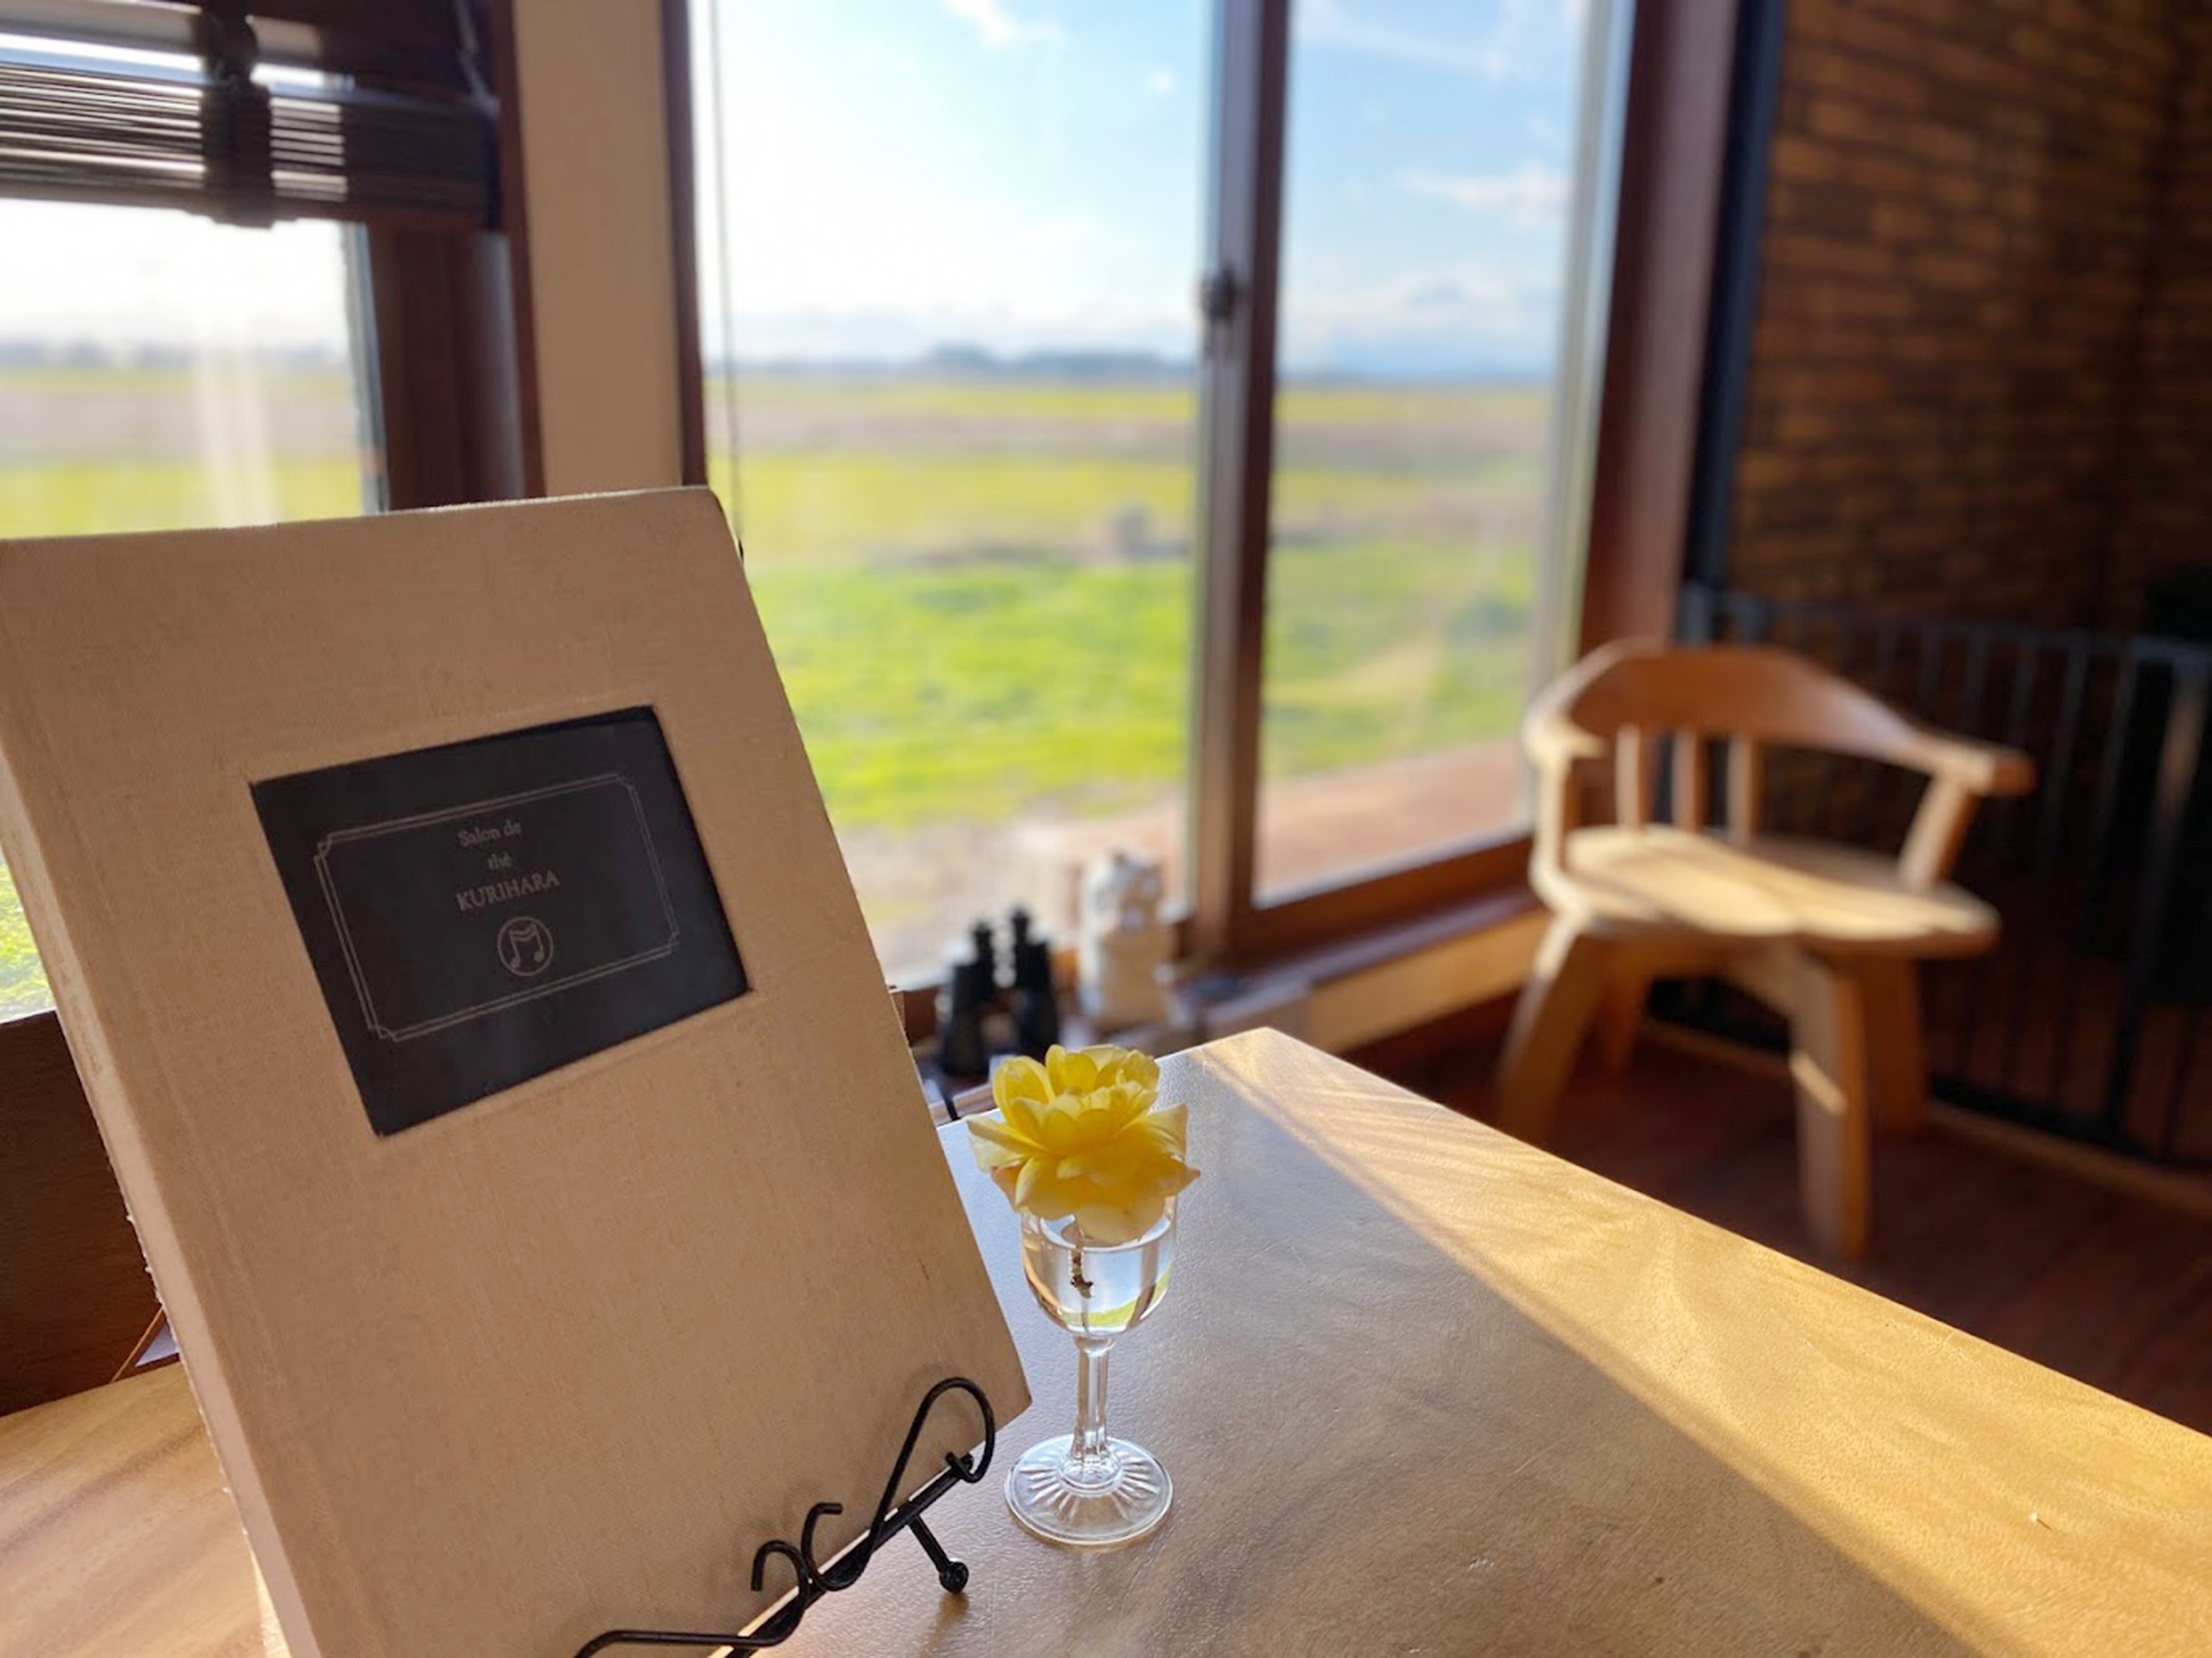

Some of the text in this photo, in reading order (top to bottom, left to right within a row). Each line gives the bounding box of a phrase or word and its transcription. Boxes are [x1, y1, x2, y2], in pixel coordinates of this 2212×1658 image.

[458, 820, 521, 847] Salon de
[456, 870, 561, 911] KURIHARA
